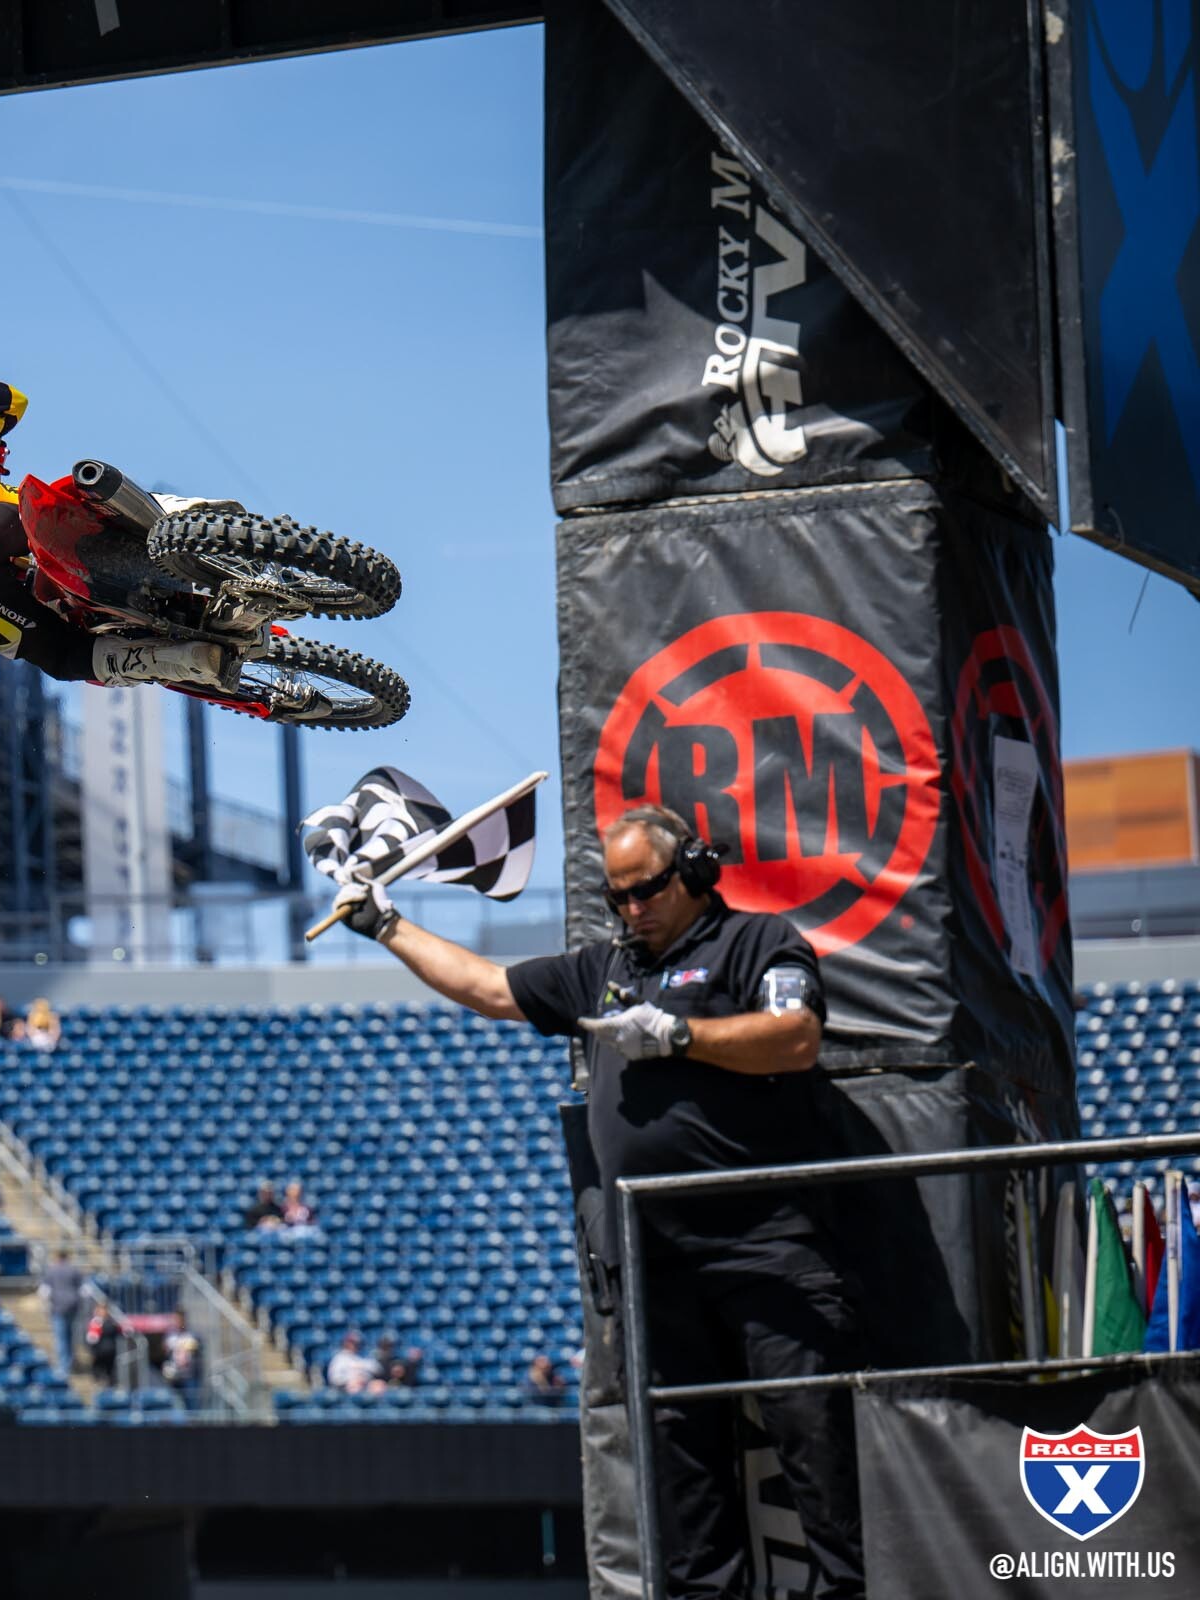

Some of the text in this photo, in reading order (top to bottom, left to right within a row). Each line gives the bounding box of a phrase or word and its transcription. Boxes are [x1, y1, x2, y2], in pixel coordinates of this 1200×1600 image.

[702, 152, 751, 393] ROCKY M
[658, 713, 877, 865] RM
